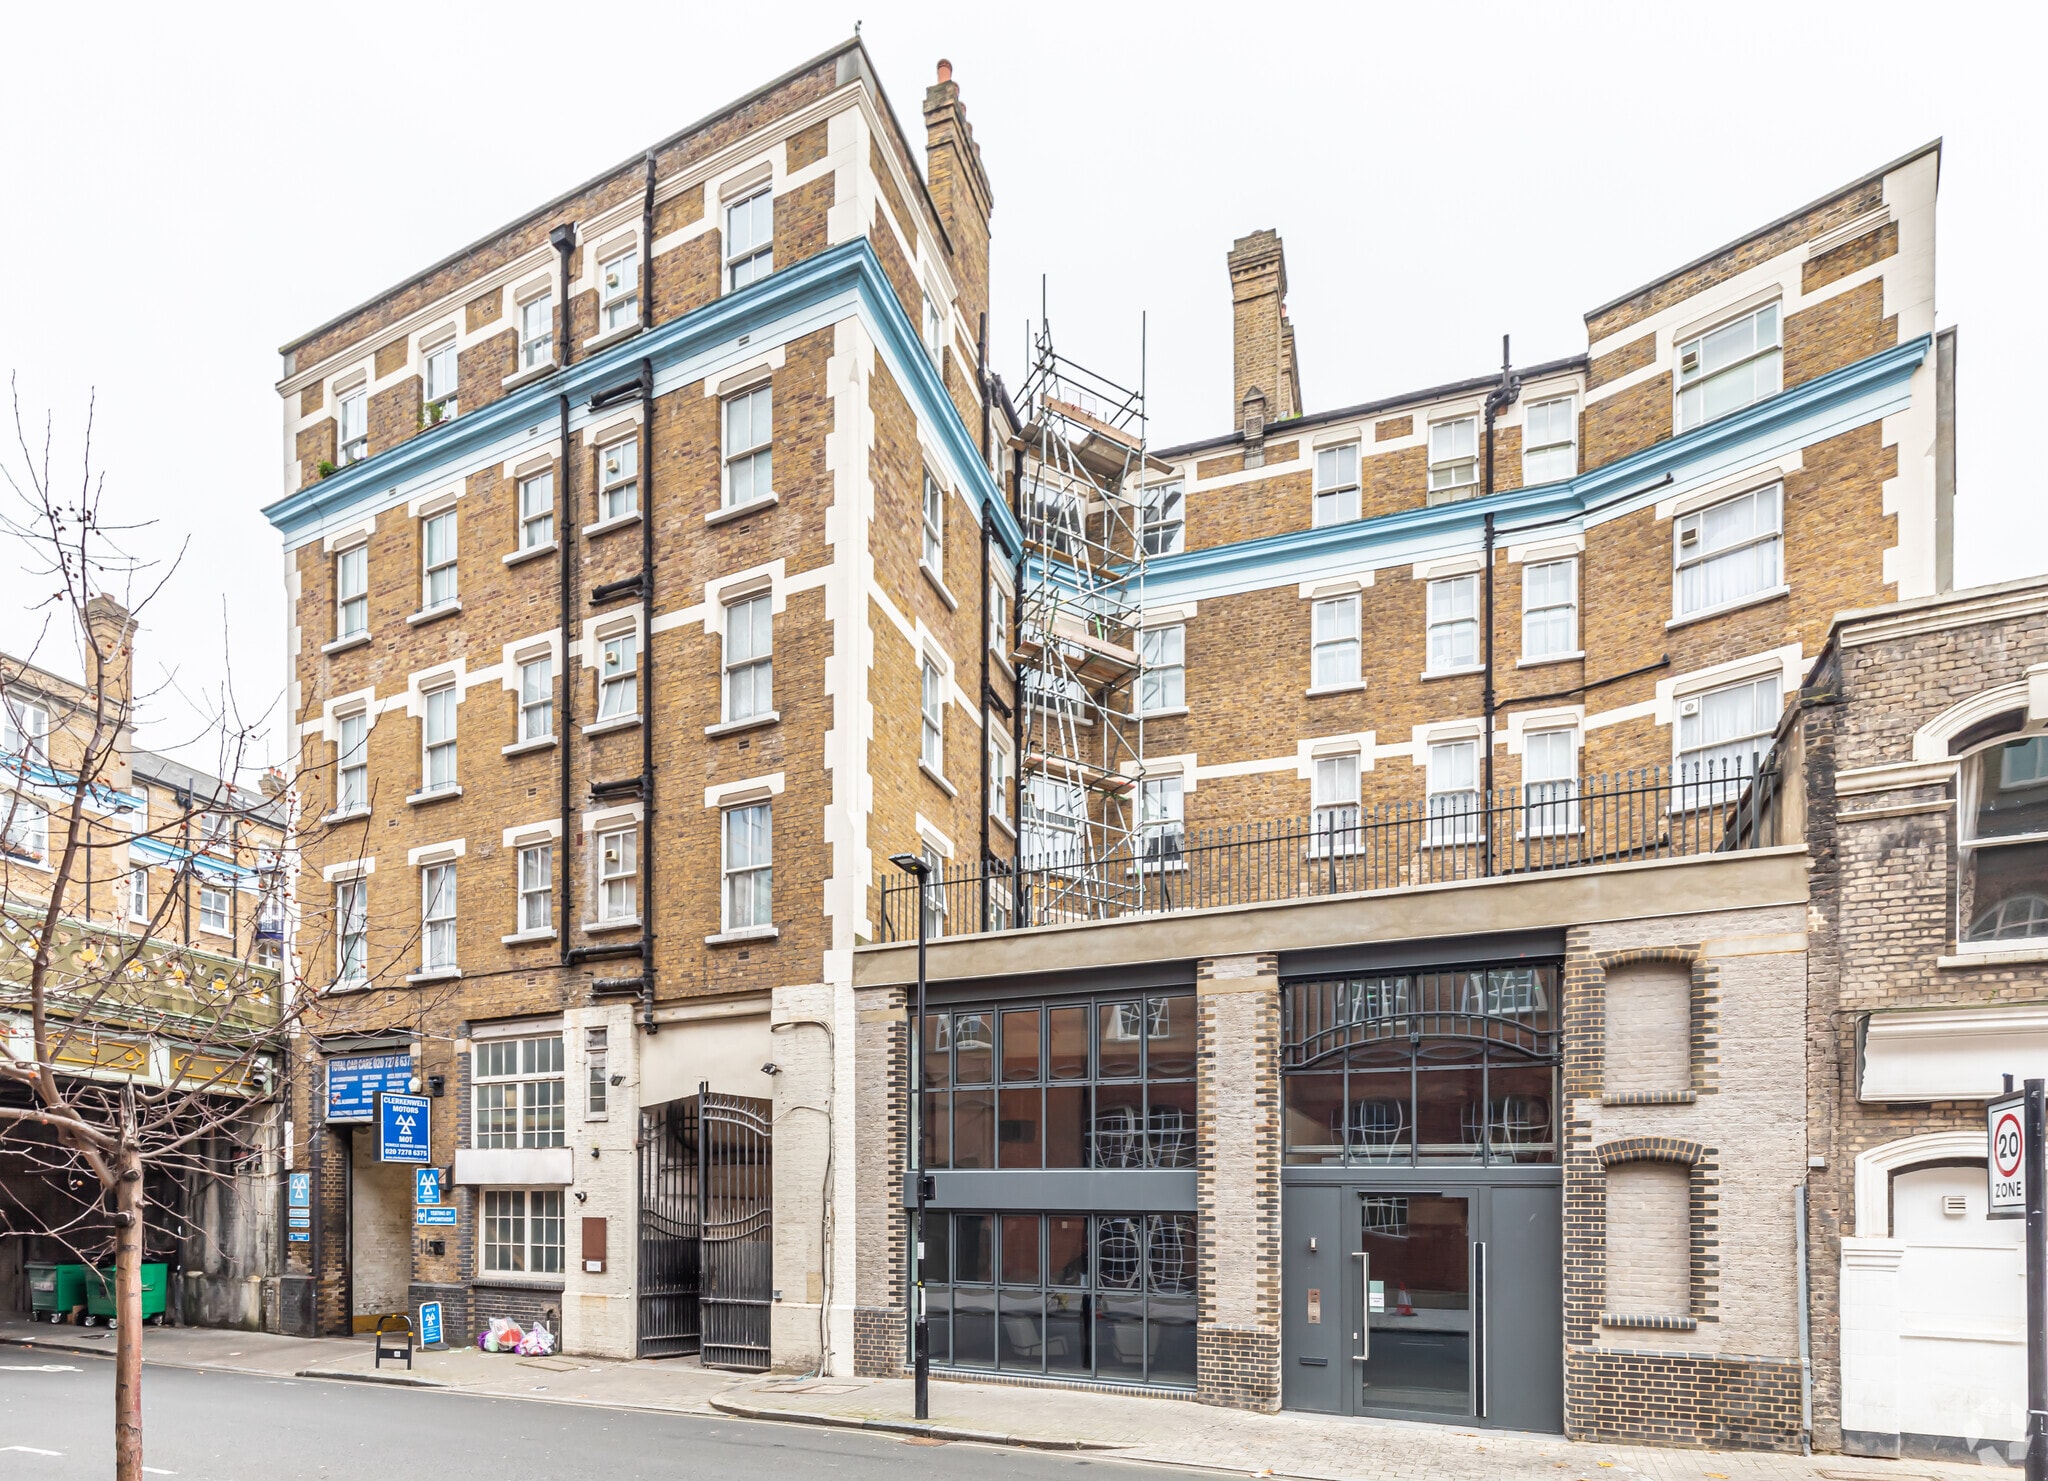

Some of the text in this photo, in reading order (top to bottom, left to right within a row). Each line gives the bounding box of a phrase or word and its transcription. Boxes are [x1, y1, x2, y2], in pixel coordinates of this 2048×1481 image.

[331, 1060, 346, 1072] TOTAL
[346, 1059, 358, 1071] CAR
[358, 1058, 373, 1070] CARE
[373, 1057, 384, 1069] 020
[400, 1055, 412, 1067] 637
[383, 1096, 427, 1107] CLERKENWELL
[392, 1105, 419, 1114] MOTORS
[398, 1135, 413, 1143] MOT
[1998, 1131, 2019, 1159] 20
[397, 1148, 412, 1156] 7278
[412, 1149, 427, 1157] 6375
[1995, 1181, 2022, 1198] ZONE
